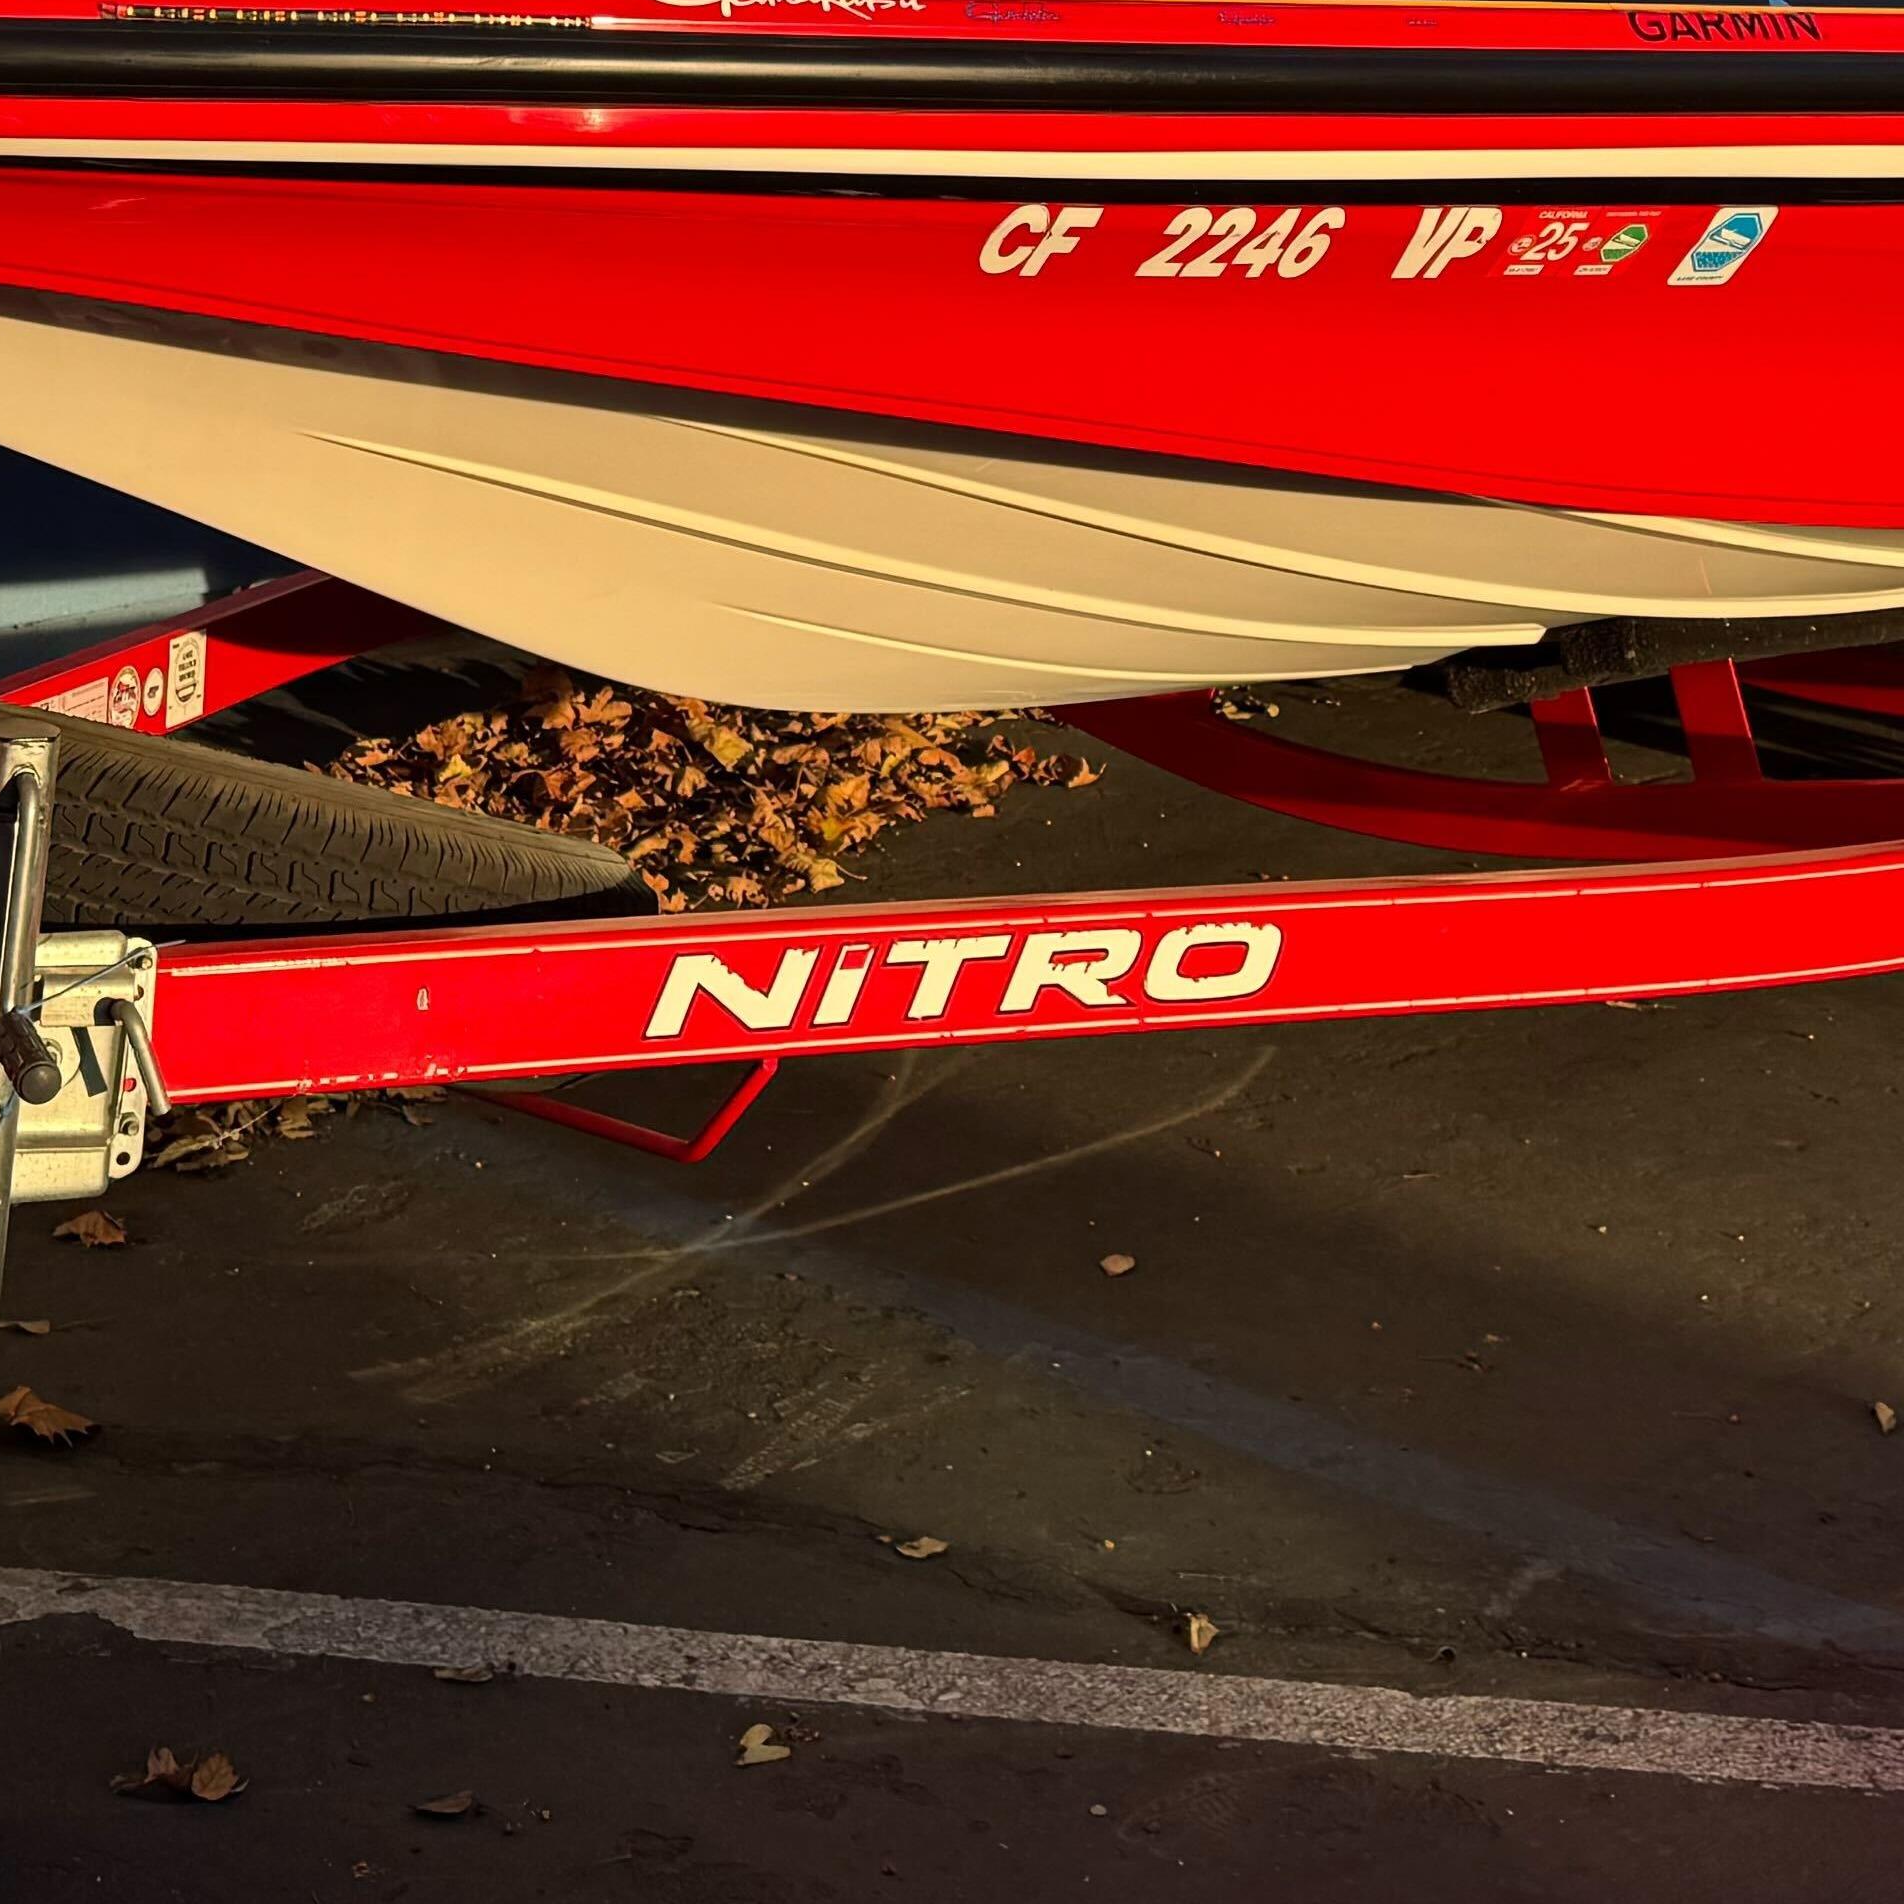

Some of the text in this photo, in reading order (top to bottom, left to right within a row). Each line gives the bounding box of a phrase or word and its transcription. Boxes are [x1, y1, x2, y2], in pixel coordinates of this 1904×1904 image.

[1627, 10, 1821, 42] GARMIN
[978, 204, 1502, 278] CF 2246 VP
[1520, 222, 1591, 261] 25
